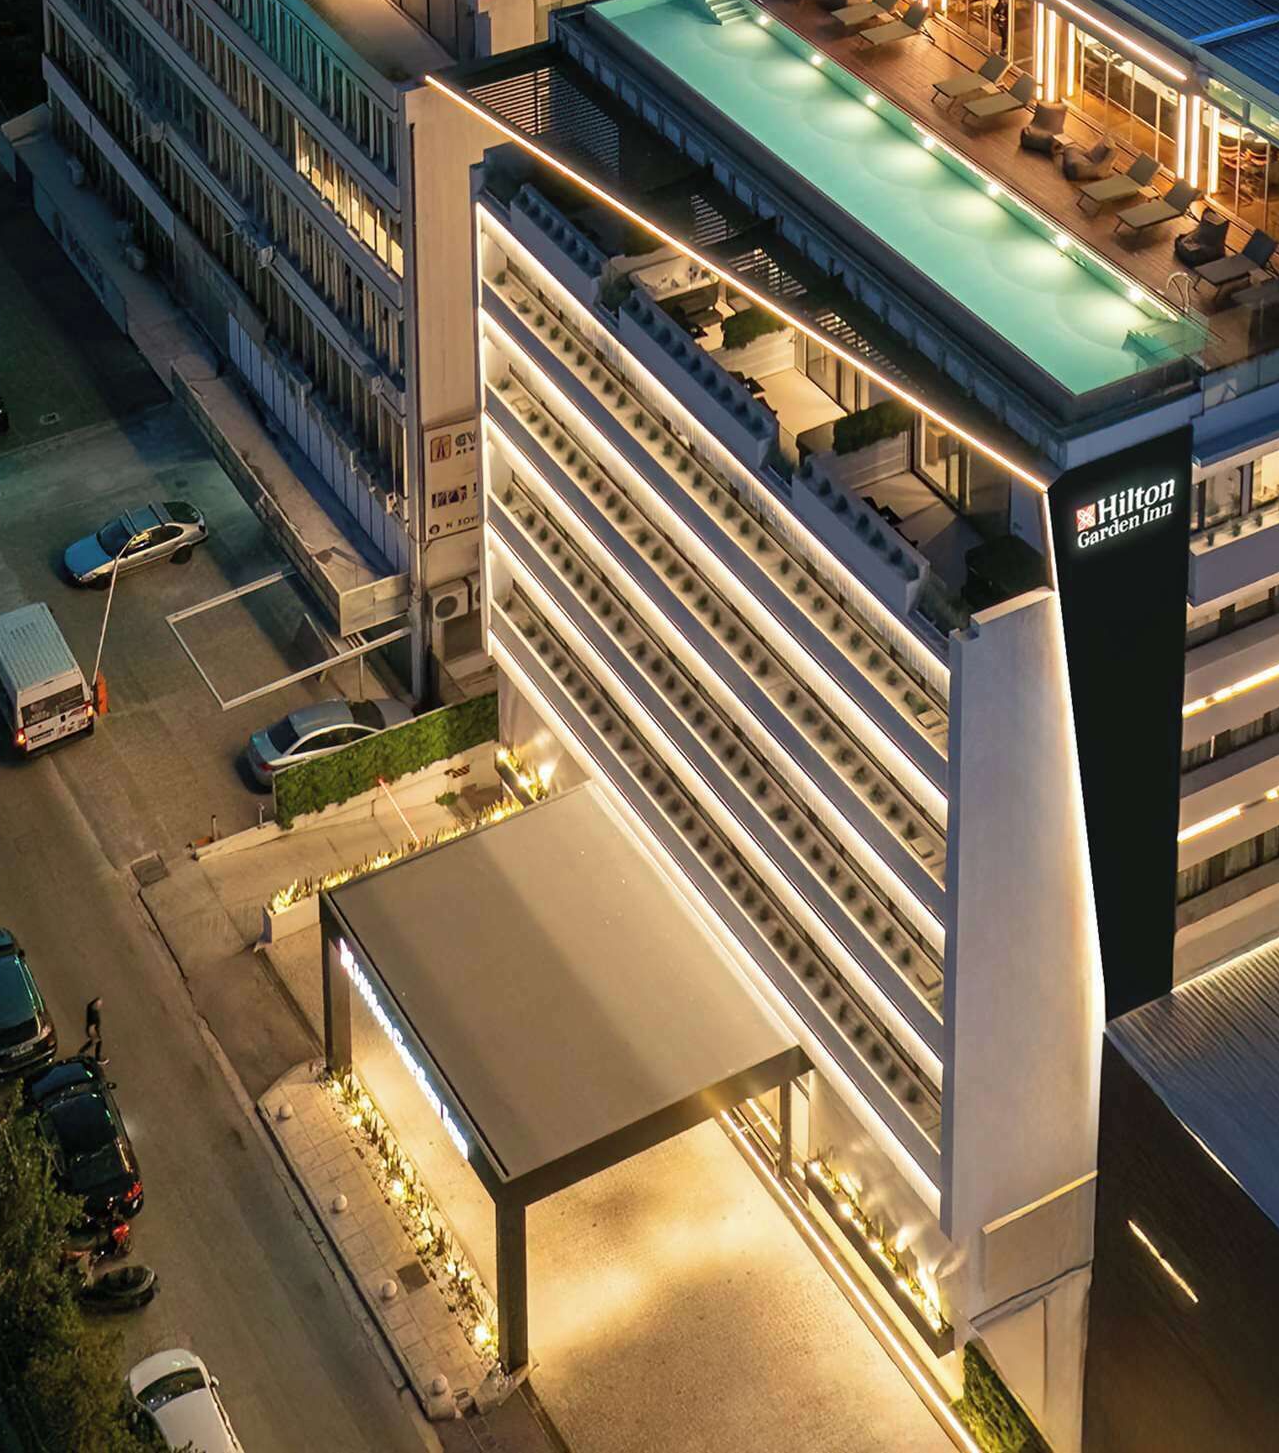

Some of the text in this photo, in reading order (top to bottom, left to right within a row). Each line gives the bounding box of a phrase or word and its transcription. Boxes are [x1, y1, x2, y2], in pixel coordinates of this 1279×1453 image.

[1097, 478, 1176, 525] Hilton
[1077, 502, 1173, 549] Garden Inn
